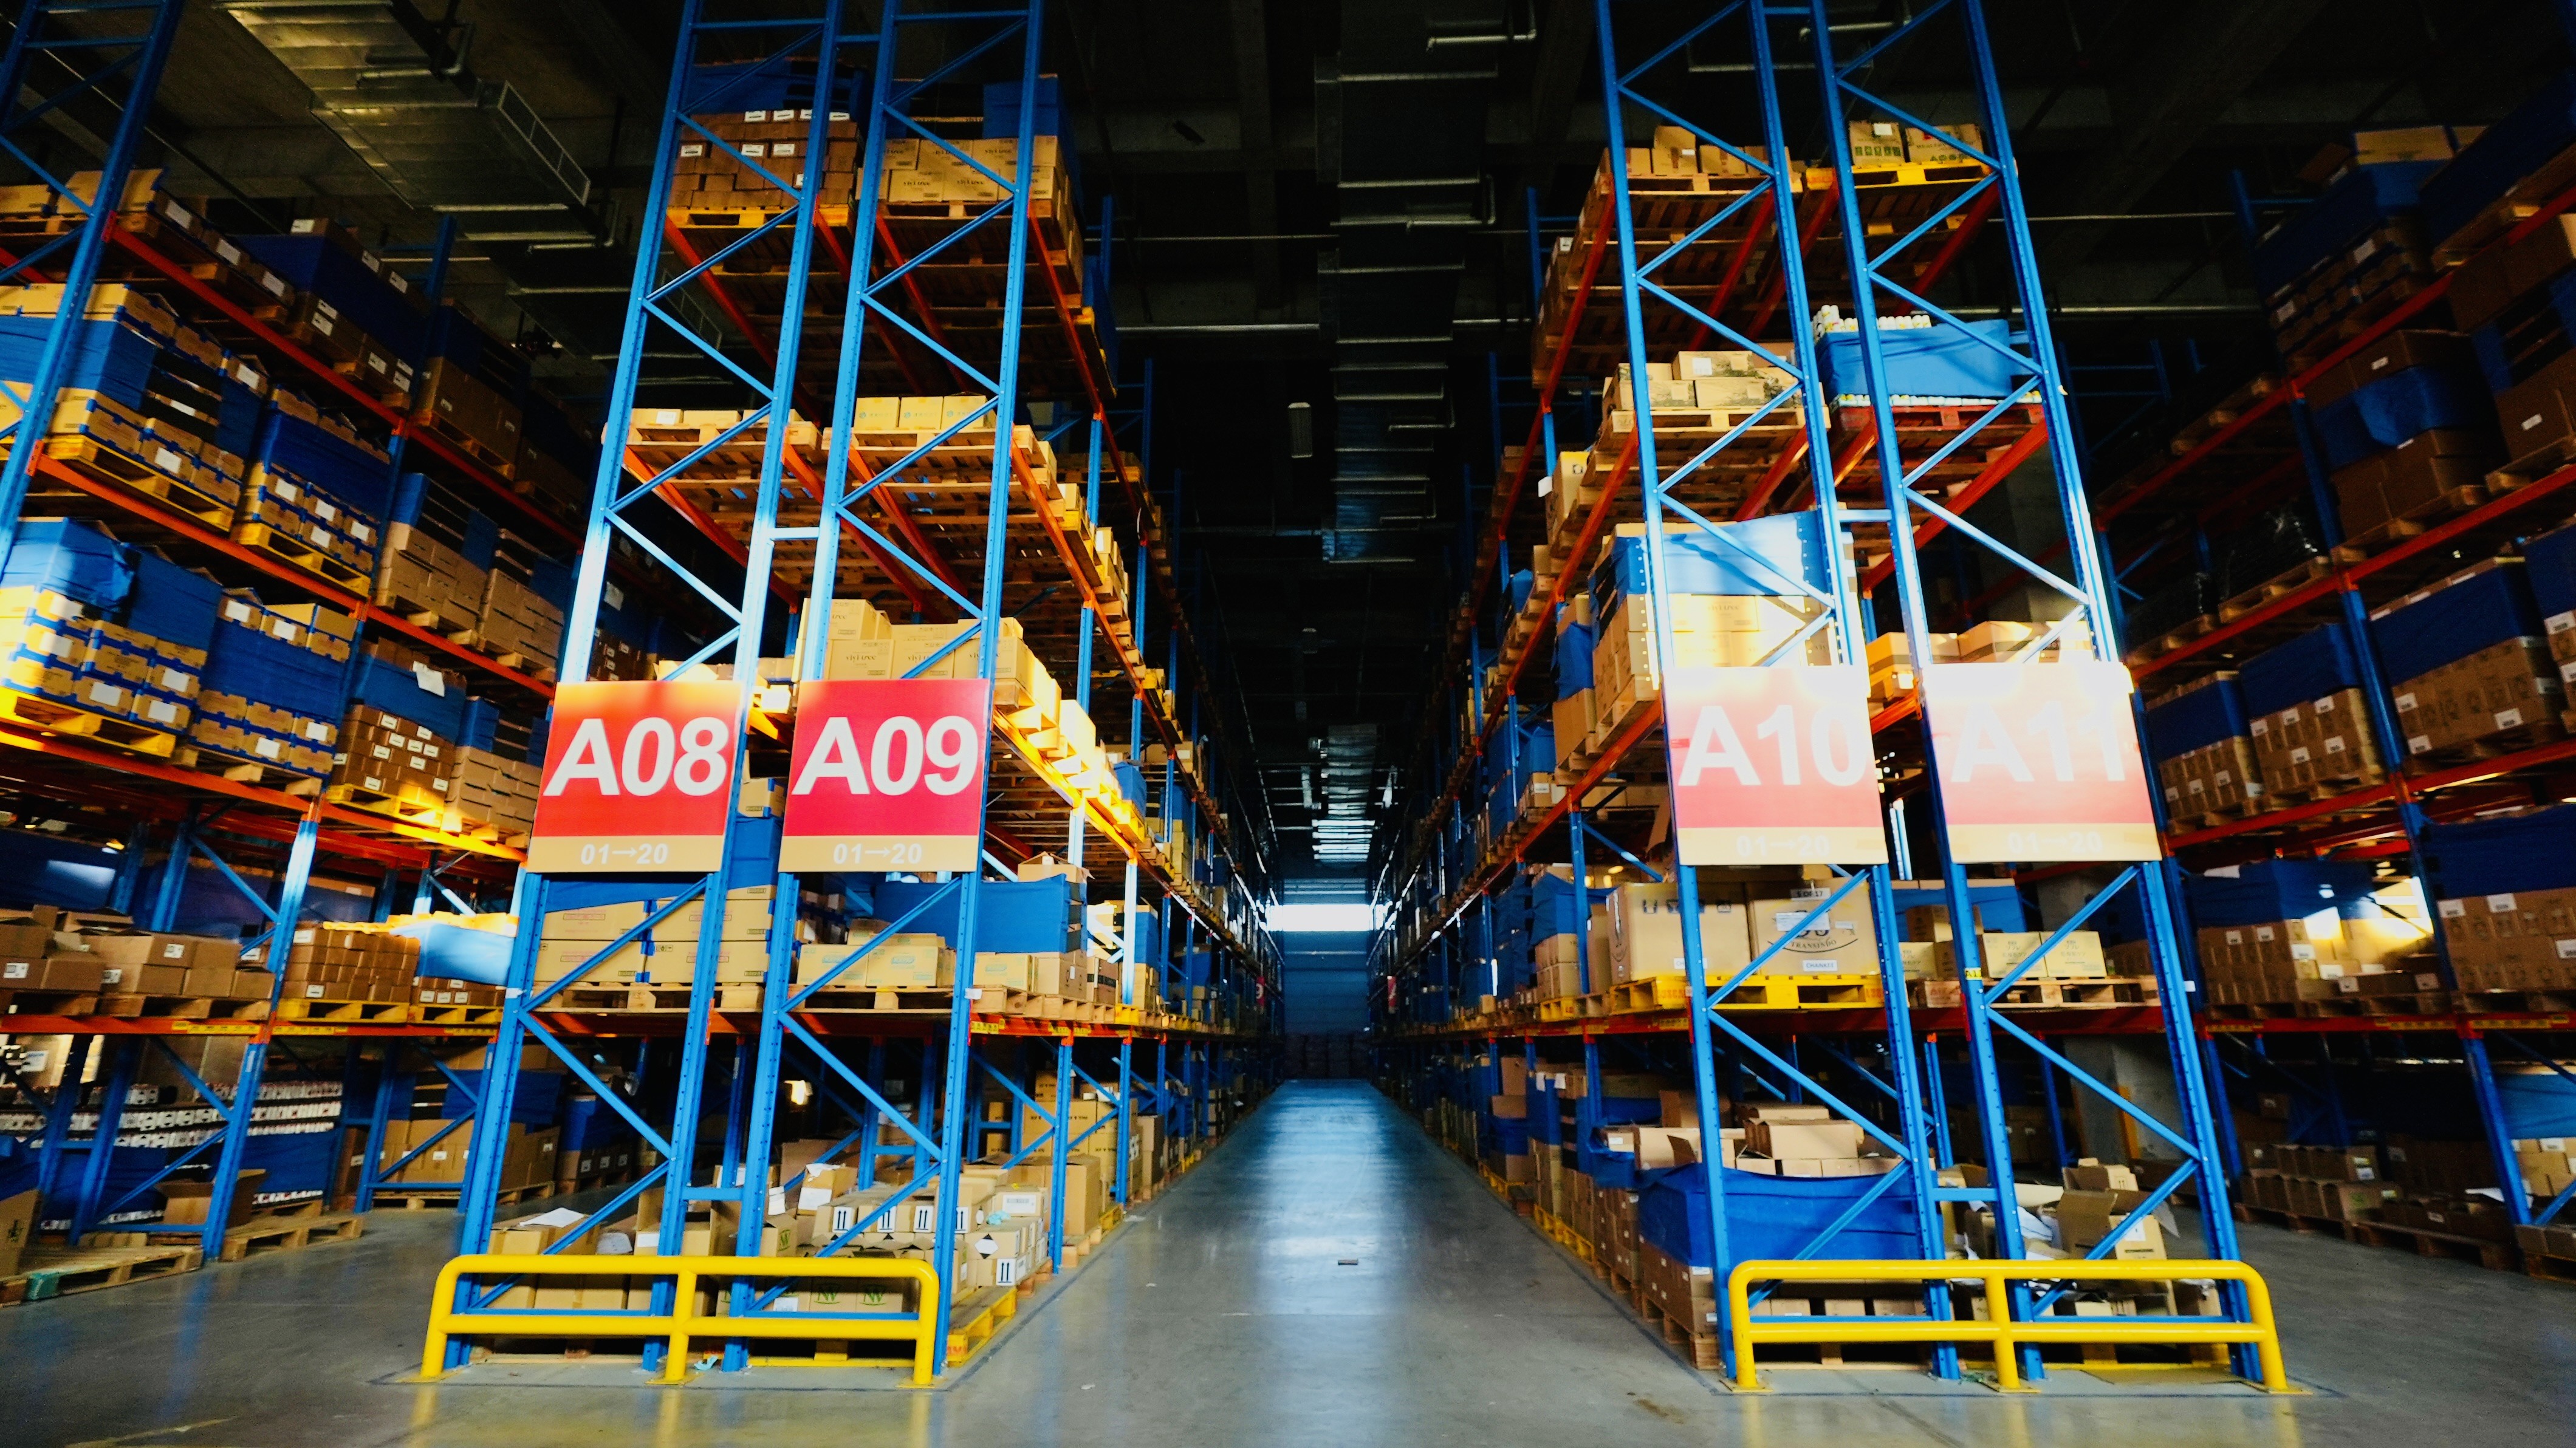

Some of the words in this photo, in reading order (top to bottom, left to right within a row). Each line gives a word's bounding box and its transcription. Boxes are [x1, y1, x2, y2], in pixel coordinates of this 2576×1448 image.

[543, 716, 728, 796] A08
[791, 715, 978, 796] A09
[1677, 703, 1867, 787] A10
[1950, 700, 2126, 783] A11
